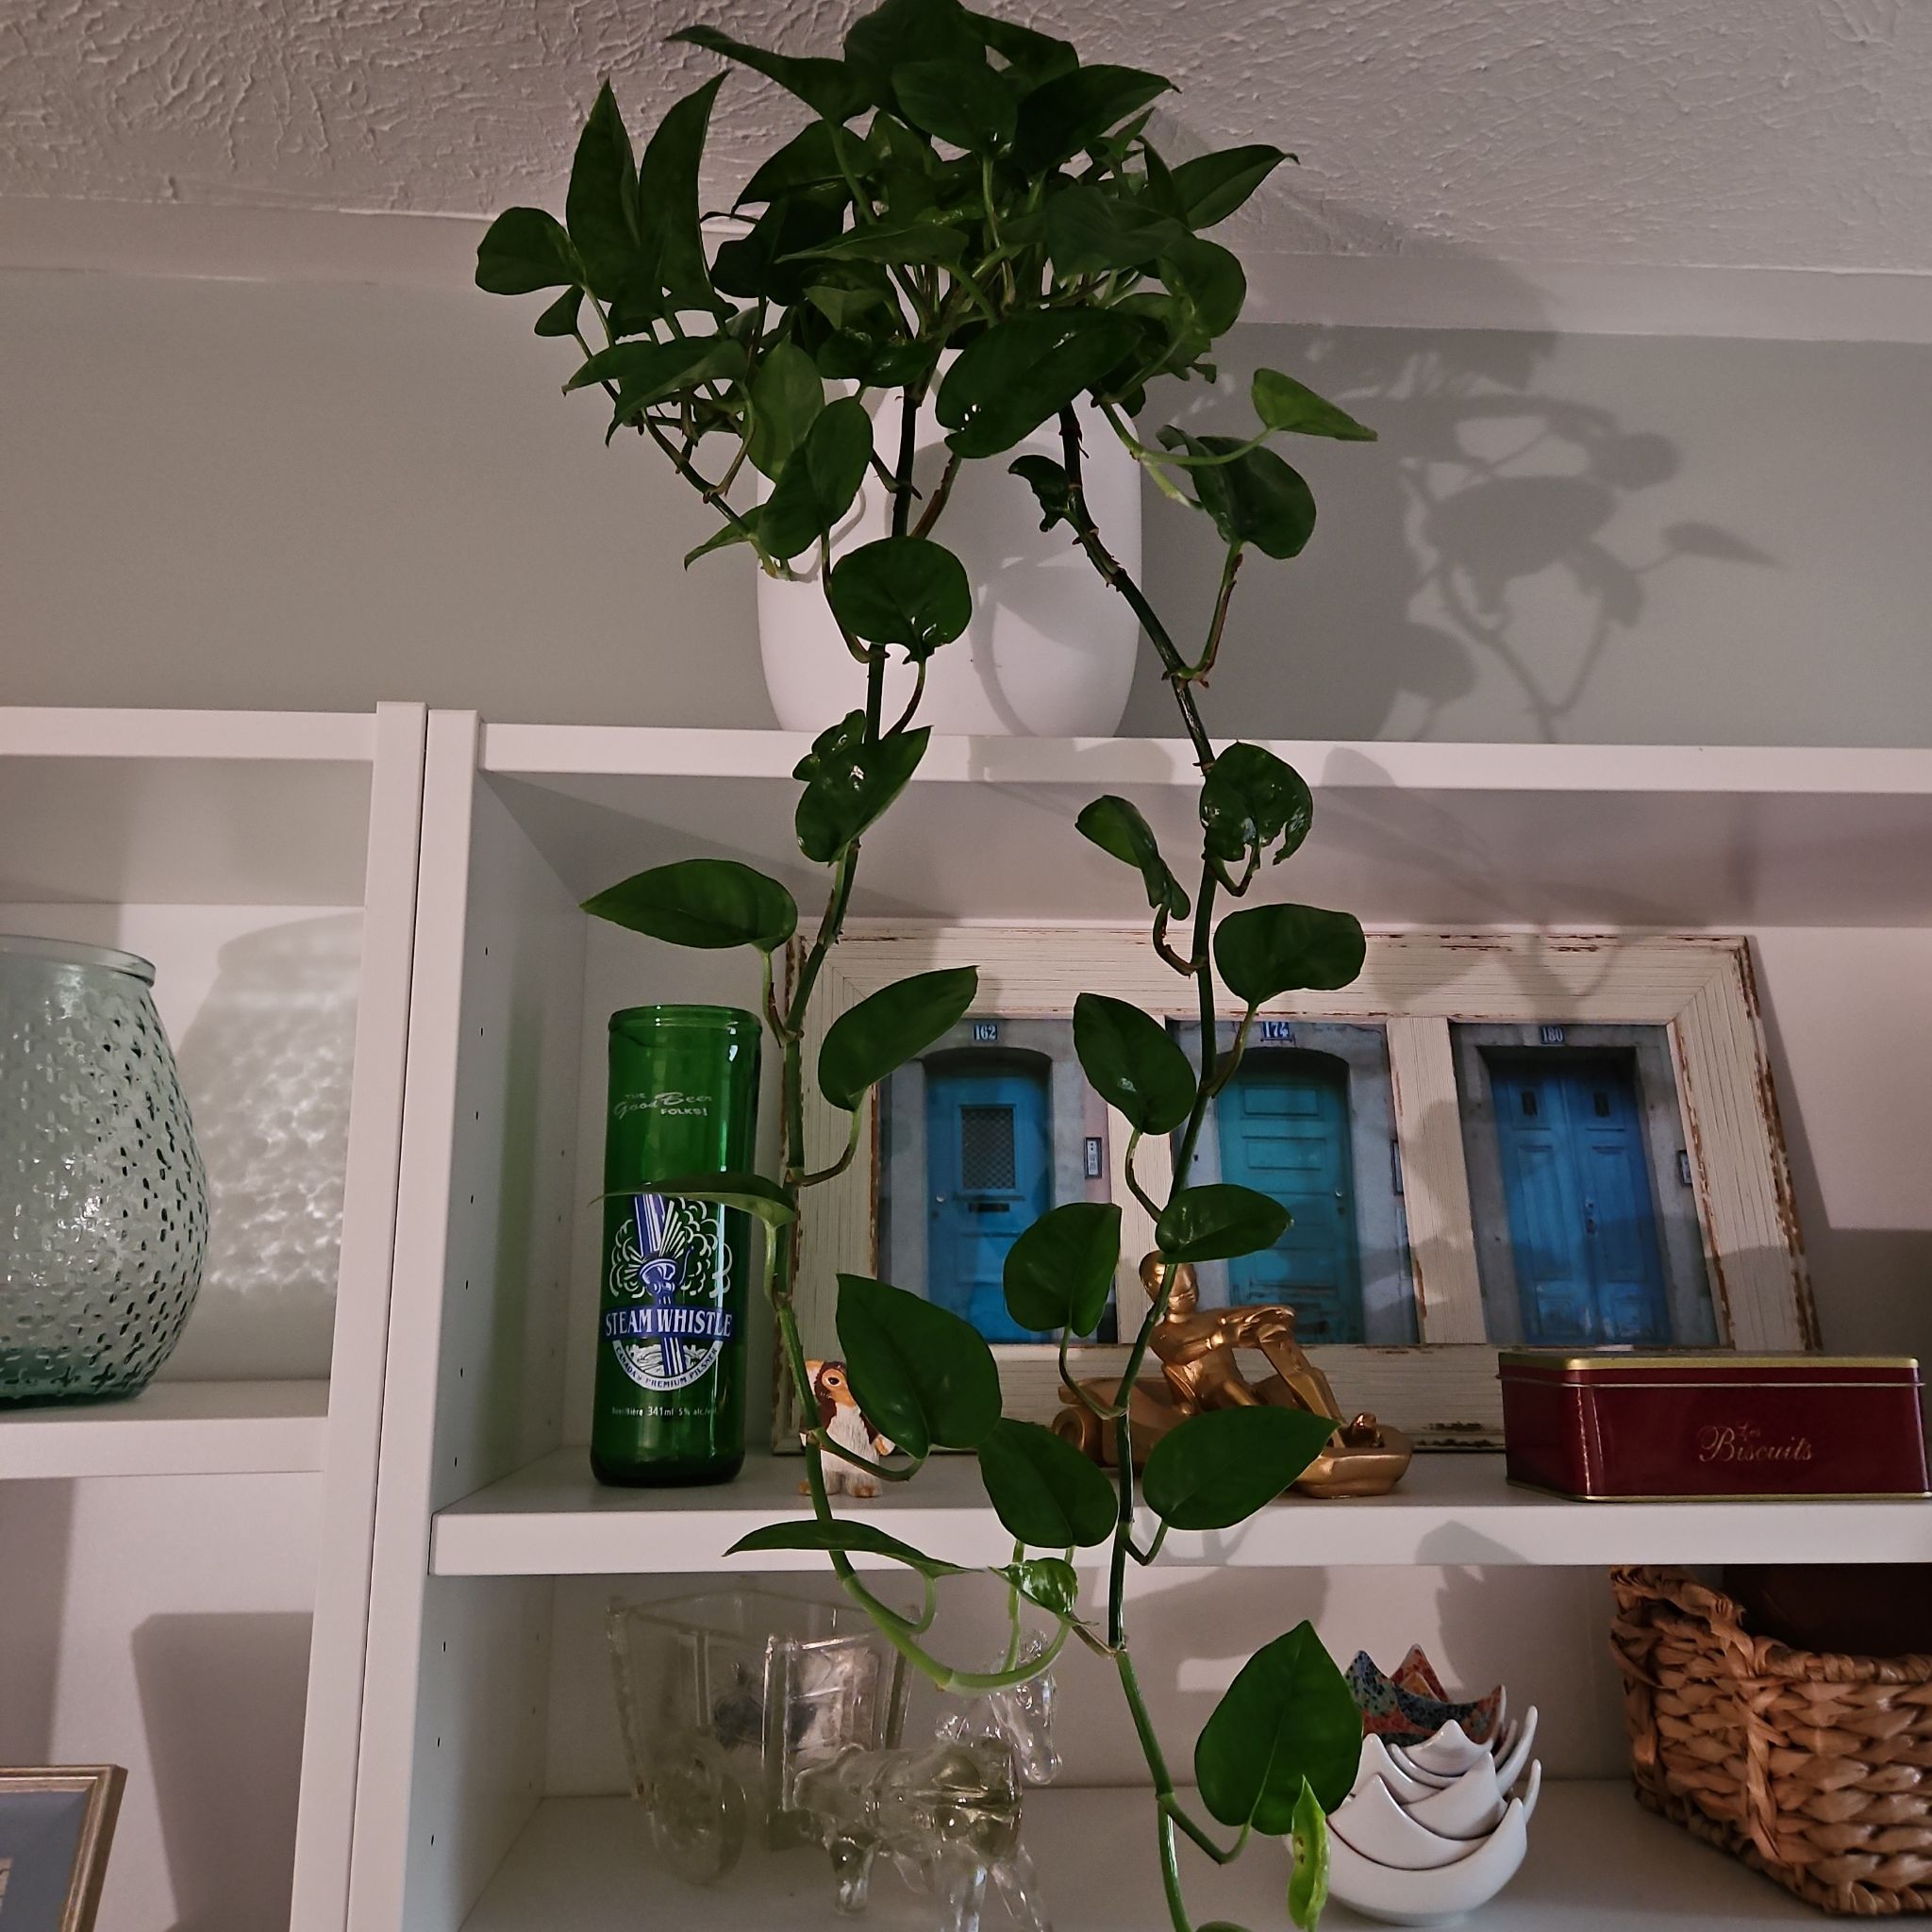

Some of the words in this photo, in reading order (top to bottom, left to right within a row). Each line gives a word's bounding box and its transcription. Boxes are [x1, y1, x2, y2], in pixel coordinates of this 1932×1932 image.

[975, 1024, 996, 1041] 162
[1542, 1026, 1563, 1042] 180
[614, 1100, 658, 1120] Good
[655, 1091, 712, 1106] Beer
[660, 1108, 708, 1117] FOLKS!
[606, 1308, 652, 1337] STEAM
[657, 1308, 733, 1337] WHISTLE
[615, 1346, 642, 1381] CANADA'S
[644, 1376, 688, 1389] PREMIUM
[690, 1347, 718, 1380] PILSNER
[678, 1407, 691, 1416] 5%
[1698, 1424, 1812, 1462] Biscuits
